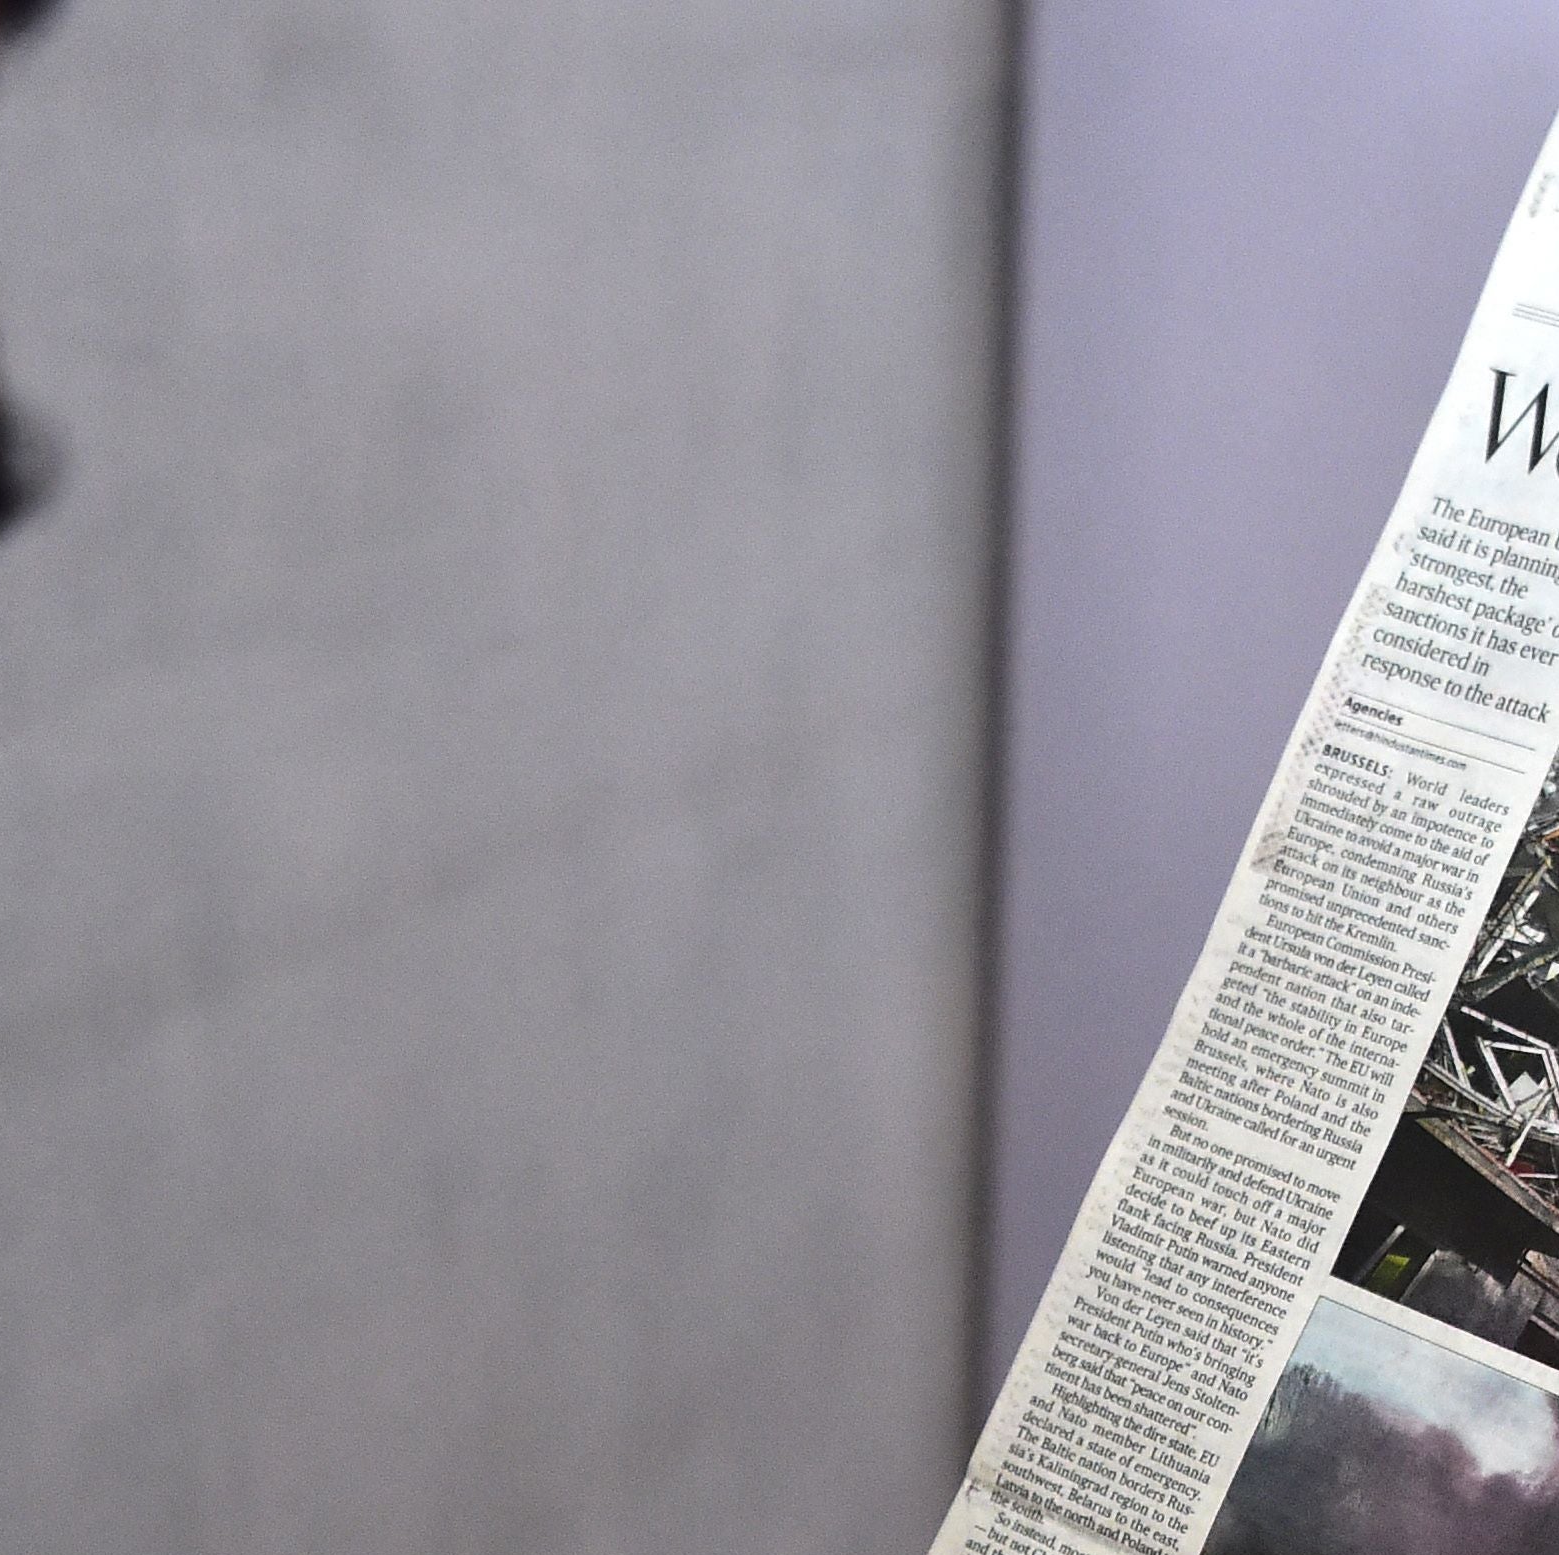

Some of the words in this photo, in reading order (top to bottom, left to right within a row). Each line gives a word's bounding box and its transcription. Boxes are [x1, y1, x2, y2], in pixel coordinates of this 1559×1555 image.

[1416, 525, 1458, 550] said
[1455, 533, 1473, 554] it
[1473, 539, 1490, 559] is
[1431, 495, 1466, 523] The
[1466, 507, 1552, 548] European
[1394, 570, 1474, 613] harshest
[1498, 575, 1529, 600] the
[1372, 628, 1473, 671] considered
[1470, 655, 1492, 678] in
[1382, 601, 1470, 641] sanctions
[1468, 625, 1487, 647] it
[1485, 628, 1519, 656] has
[1360, 653, 1442, 692] response
[1443, 678, 1464, 698] to
[1463, 682, 1494, 707] the
[1494, 695, 1551, 724] attack
